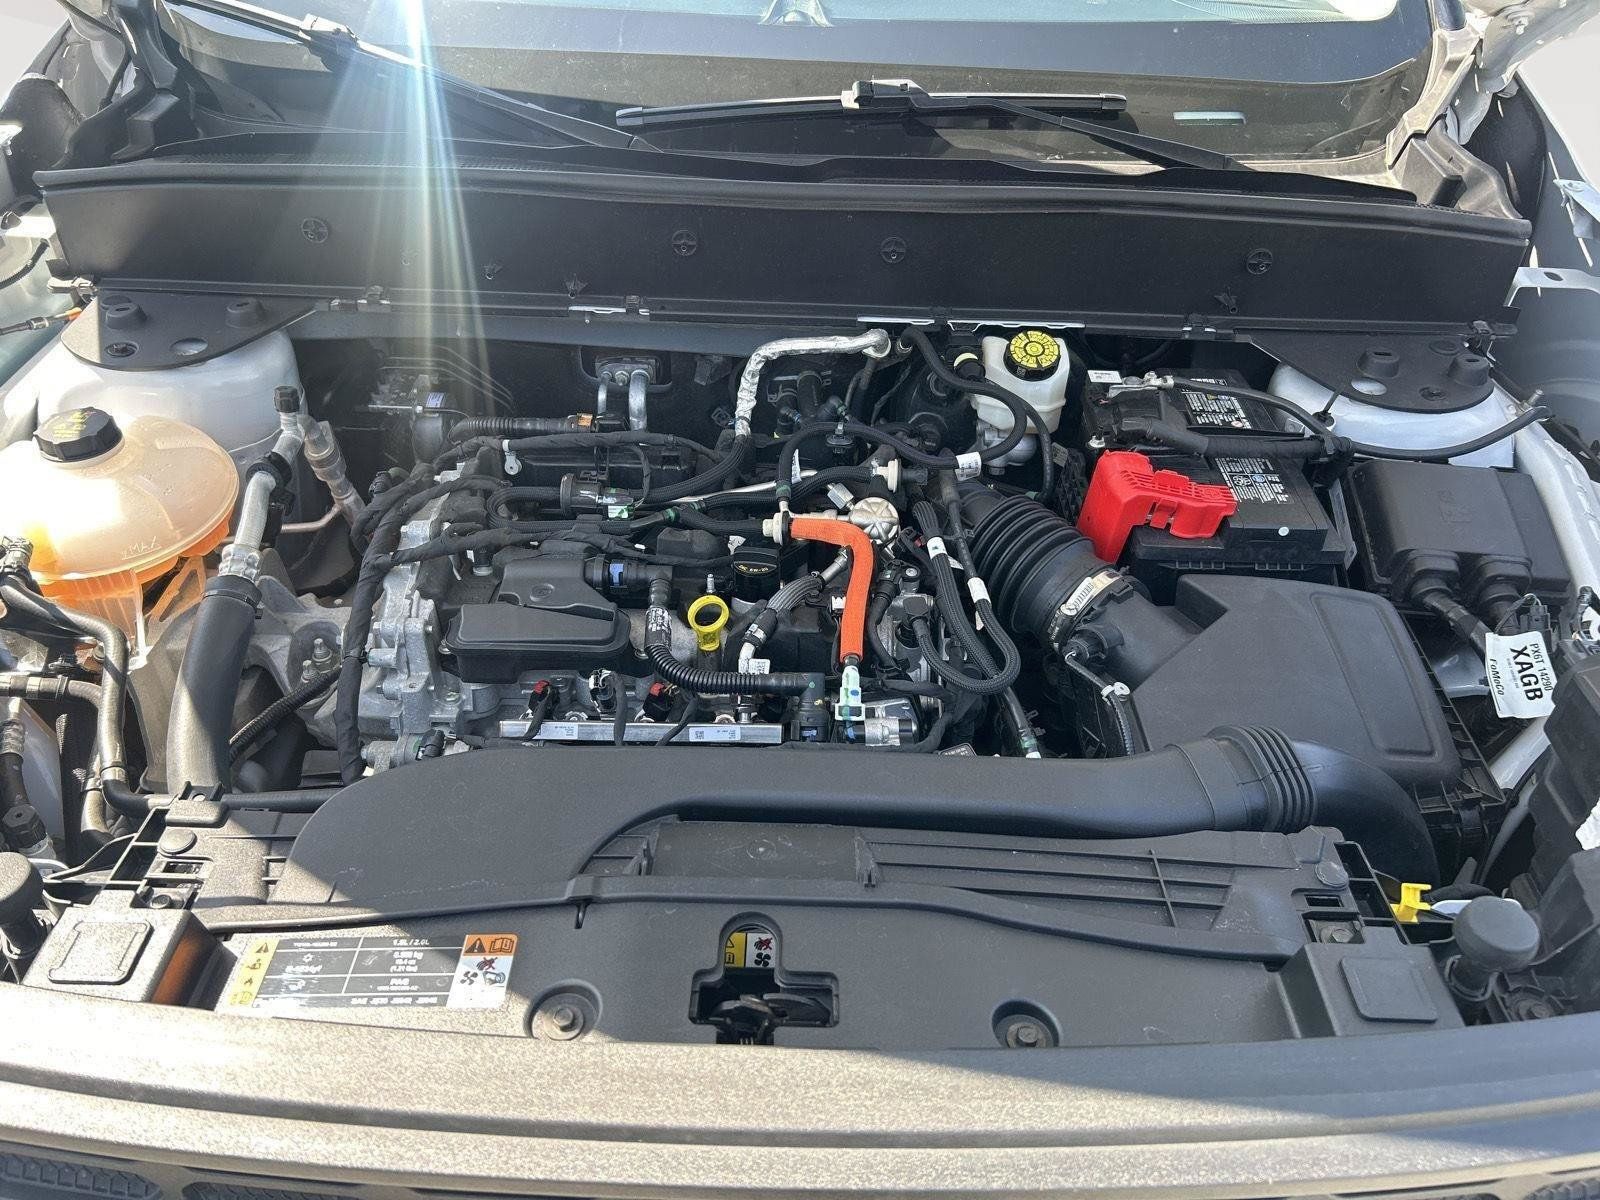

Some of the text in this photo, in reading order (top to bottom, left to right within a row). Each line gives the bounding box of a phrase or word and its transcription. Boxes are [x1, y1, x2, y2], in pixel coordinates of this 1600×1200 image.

[1489, 658, 1504, 696] FoMoCo
[1509, 645, 1543, 701] XAGB
[1529, 643, 1553, 691] PX6T 14290
